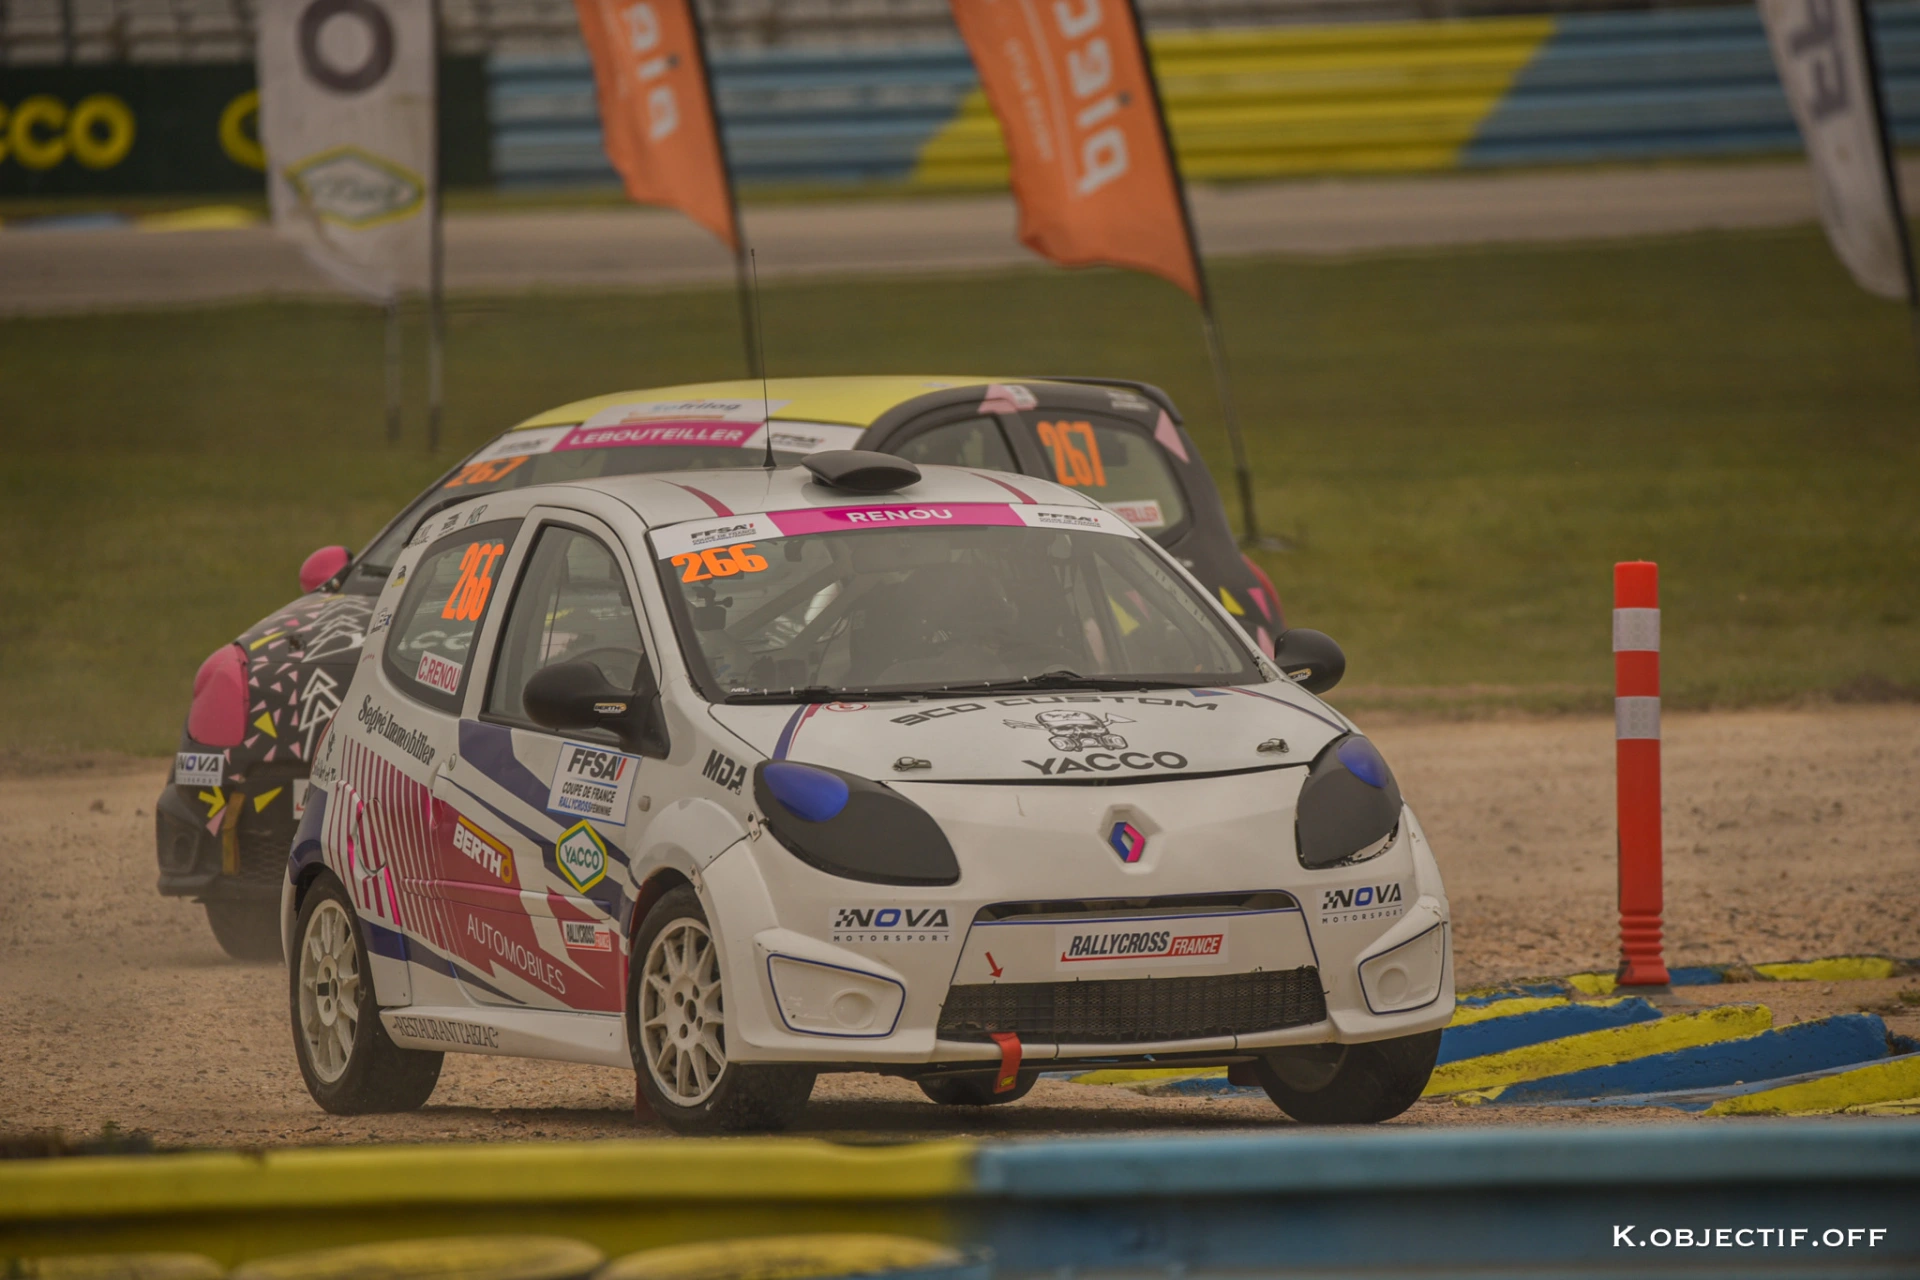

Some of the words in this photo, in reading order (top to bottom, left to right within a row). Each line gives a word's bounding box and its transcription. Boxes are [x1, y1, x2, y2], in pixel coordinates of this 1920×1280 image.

[569, 427, 743, 446] LEBOUTEILLER
[1036, 420, 1107, 487] 267
[444, 454, 529, 489] 267
[846, 508, 952, 523] RENOU
[691, 524, 747, 539] FFSA
[670, 543, 769, 584] 266
[441, 542, 505, 622] 266
[416, 655, 461, 692] C.RENOU
[995, 695, 1218, 711] CUSTOM
[383, 713, 435, 766] Immobilier
[567, 748, 619, 781] FFSA
[1023, 751, 1188, 775] YACCO
[562, 781, 584, 797] COUPE
[582, 785, 592, 798] DE
[591, 787, 617, 803] FRANCE
[565, 843, 599, 871] YACCO
[1322, 883, 1402, 909] NOVA
[835, 909, 949, 927] NOVA
[1322, 909, 1403, 924] MOTORSPORT
[467, 913, 566, 996] AUTOMOBILES
[1069, 931, 1170, 956] RALLYCROSS
[1171, 937, 1220, 955] FRANCE
[395, 1015, 460, 1043] RESTAURANT
